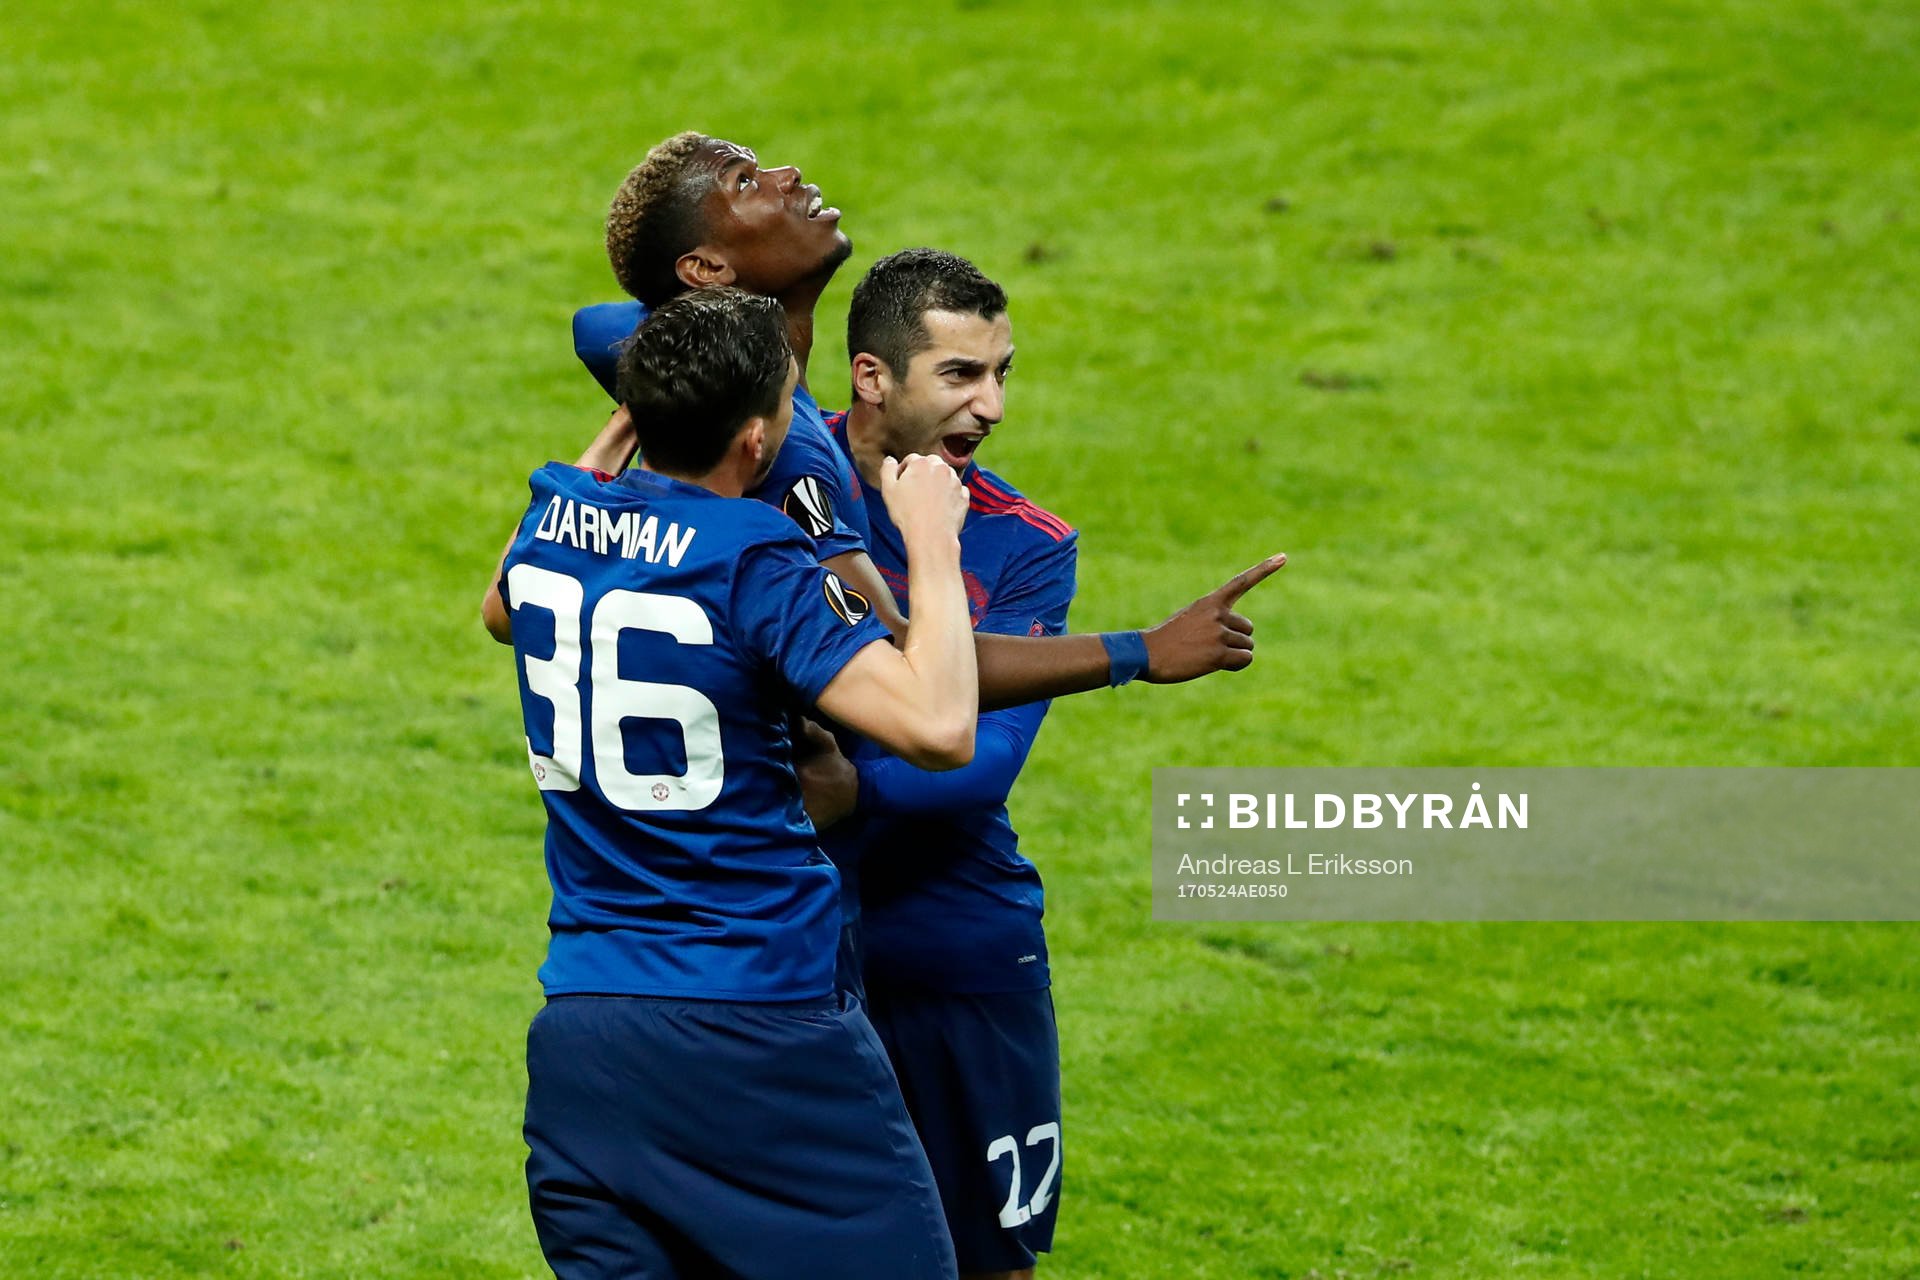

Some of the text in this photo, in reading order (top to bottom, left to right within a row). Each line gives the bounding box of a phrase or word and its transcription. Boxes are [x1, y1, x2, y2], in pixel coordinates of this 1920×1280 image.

[535, 495, 696, 567] DARMIAN
[507, 563, 724, 811] 36
[987, 1121, 1060, 1229] 22
